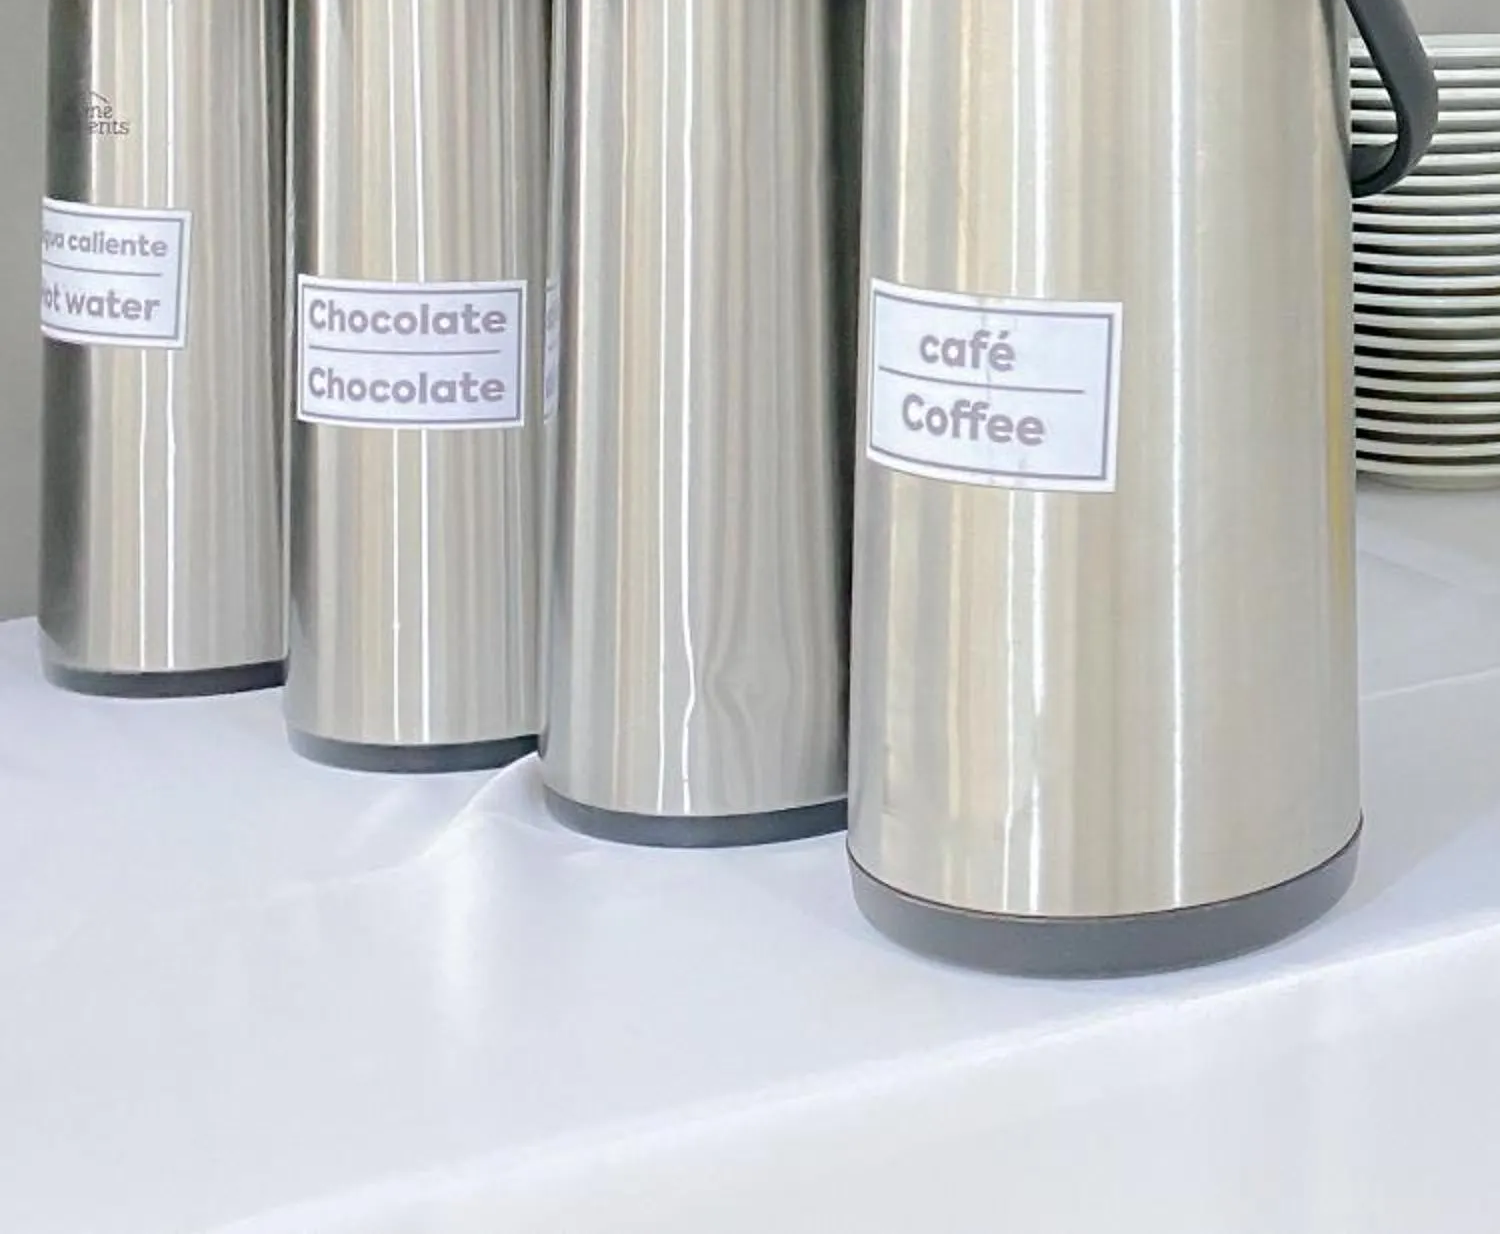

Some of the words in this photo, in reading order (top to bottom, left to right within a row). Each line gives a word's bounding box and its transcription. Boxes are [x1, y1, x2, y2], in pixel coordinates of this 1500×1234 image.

[67, 230, 168, 257] caliente
[41, 280, 61, 313] ot
[65, 288, 161, 322] water
[308, 298, 507, 335] Chocolate
[919, 329, 1016, 372] café
[307, 366, 506, 404] Chocolate
[901, 393, 1046, 446] Coffee
